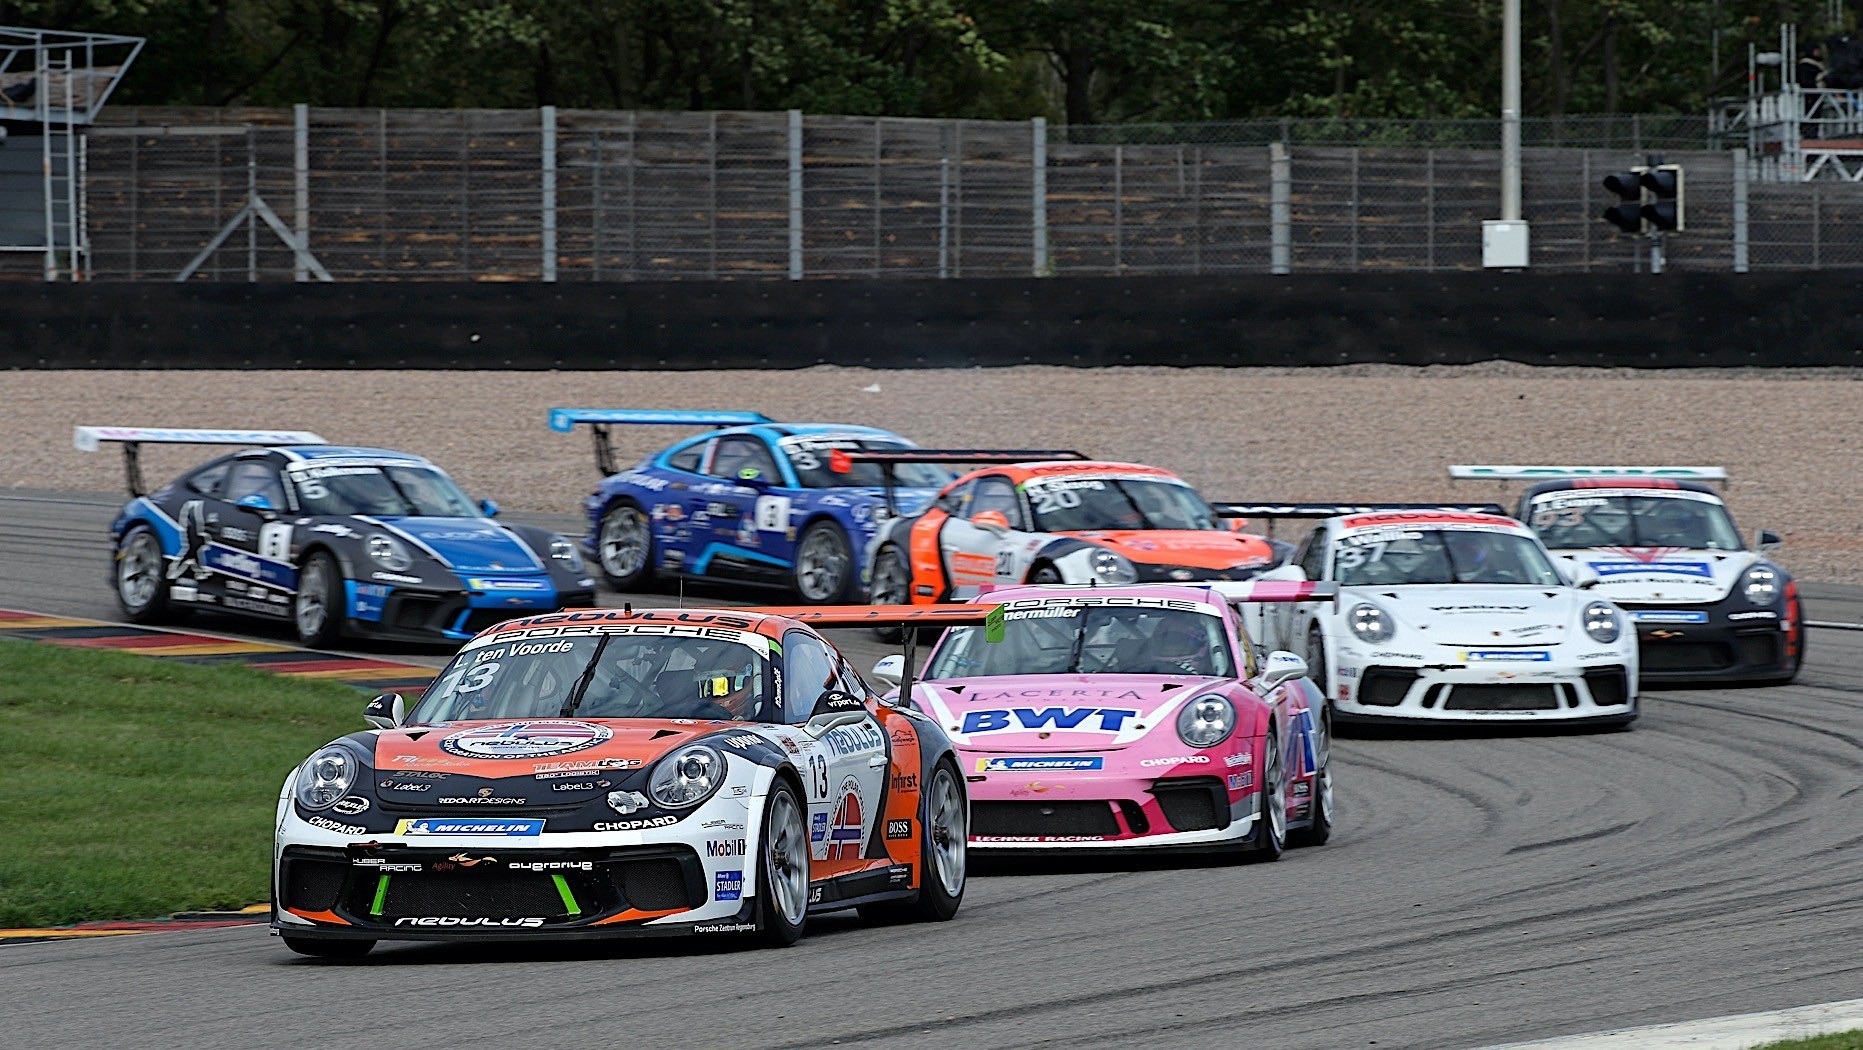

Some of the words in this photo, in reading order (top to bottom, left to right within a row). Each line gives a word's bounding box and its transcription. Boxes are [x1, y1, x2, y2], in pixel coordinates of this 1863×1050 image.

[790, 452, 821, 470] 3
[301, 480, 330, 499] 5
[1030, 490, 1082, 515] 20
[1003, 598, 1196, 610] ORSCHE
[492, 625, 743, 643] PORSCHE
[453, 655, 469, 669] L.
[475, 648, 505, 664] ten
[508, 639, 575, 658] Voorde
[440, 661, 501, 700] 13
[969, 689, 1147, 702] LACERTA
[961, 707, 1137, 734] BWT
[1010, 760, 1094, 768] MICHELIN
[1140, 755, 1211, 767] CHOPARD
[808, 754, 829, 799] 13
[308, 815, 367, 836] CHOPARD
[434, 823, 531, 832] MICHELIN
[593, 814, 678, 831] CHOPARD
[888, 821, 909, 834] BOSS
[706, 839, 737, 857] Mobil
[716, 880, 741, 892] STADLER
[394, 916, 547, 928] nebulus
[694, 924, 719, 933] Porsche
